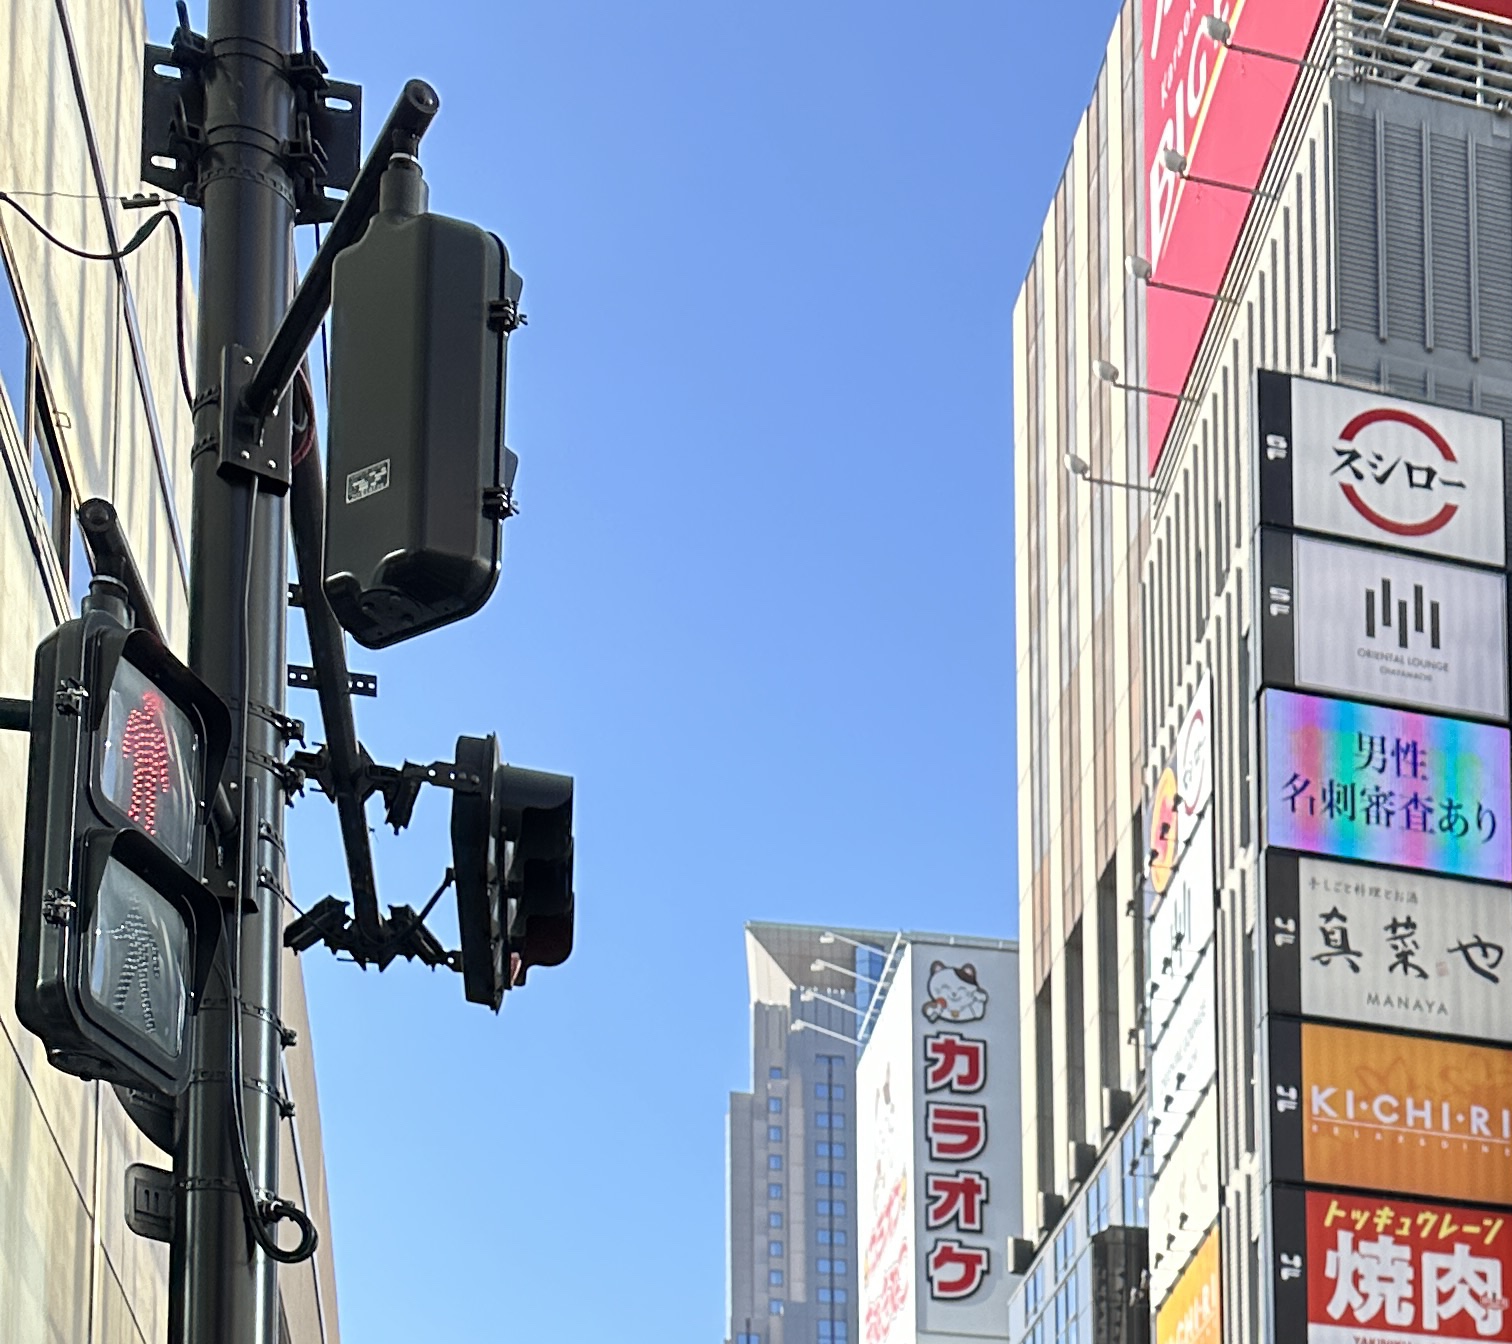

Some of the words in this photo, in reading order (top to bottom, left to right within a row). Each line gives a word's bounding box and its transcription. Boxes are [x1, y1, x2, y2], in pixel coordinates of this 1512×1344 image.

[1330, 447, 1467, 493] スシロー
[1352, 733, 1429, 782] 男性
[1281, 772, 1498, 844] 名刺審査あり
[1366, 992, 1449, 1016] MANAYA
[924, 1031, 990, 1300] カラオケ
[1323, 1200, 1505, 1245] トッキュウレーン
[1324, 1229, 1504, 1337] 焼肉
